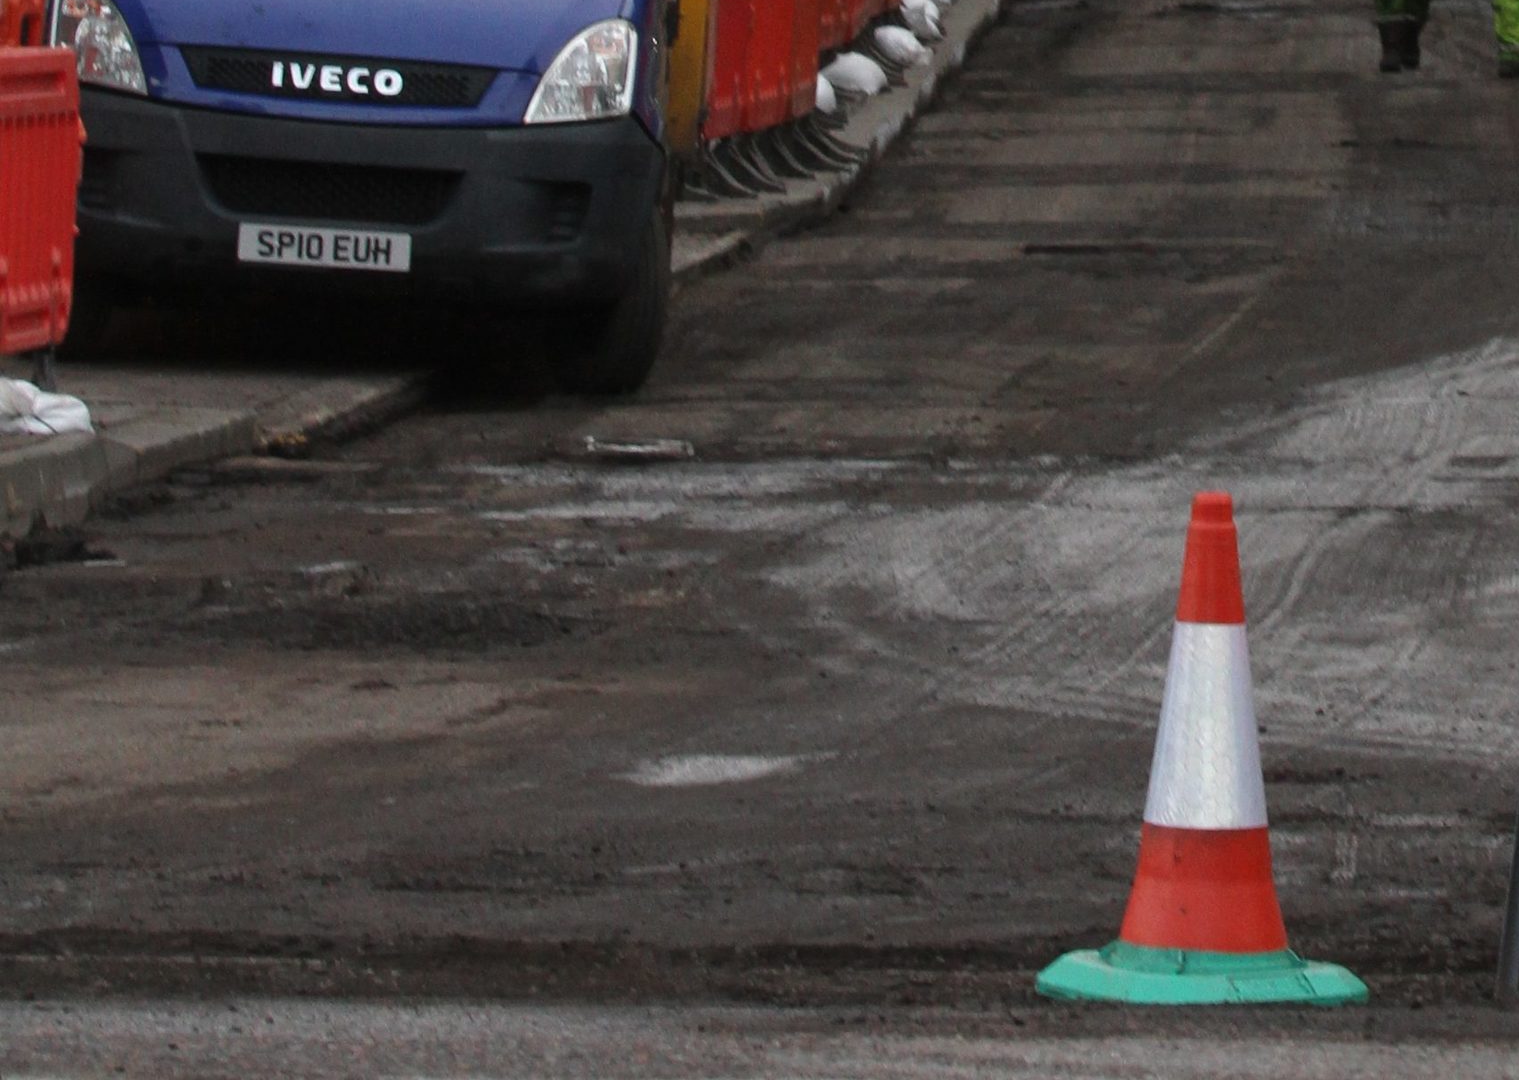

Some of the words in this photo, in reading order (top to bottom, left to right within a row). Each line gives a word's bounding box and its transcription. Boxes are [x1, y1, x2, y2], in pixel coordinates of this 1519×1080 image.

[272, 60, 404, 96] IVECO
[257, 230, 324, 261] SP10
[332, 234, 391, 265] EUH
